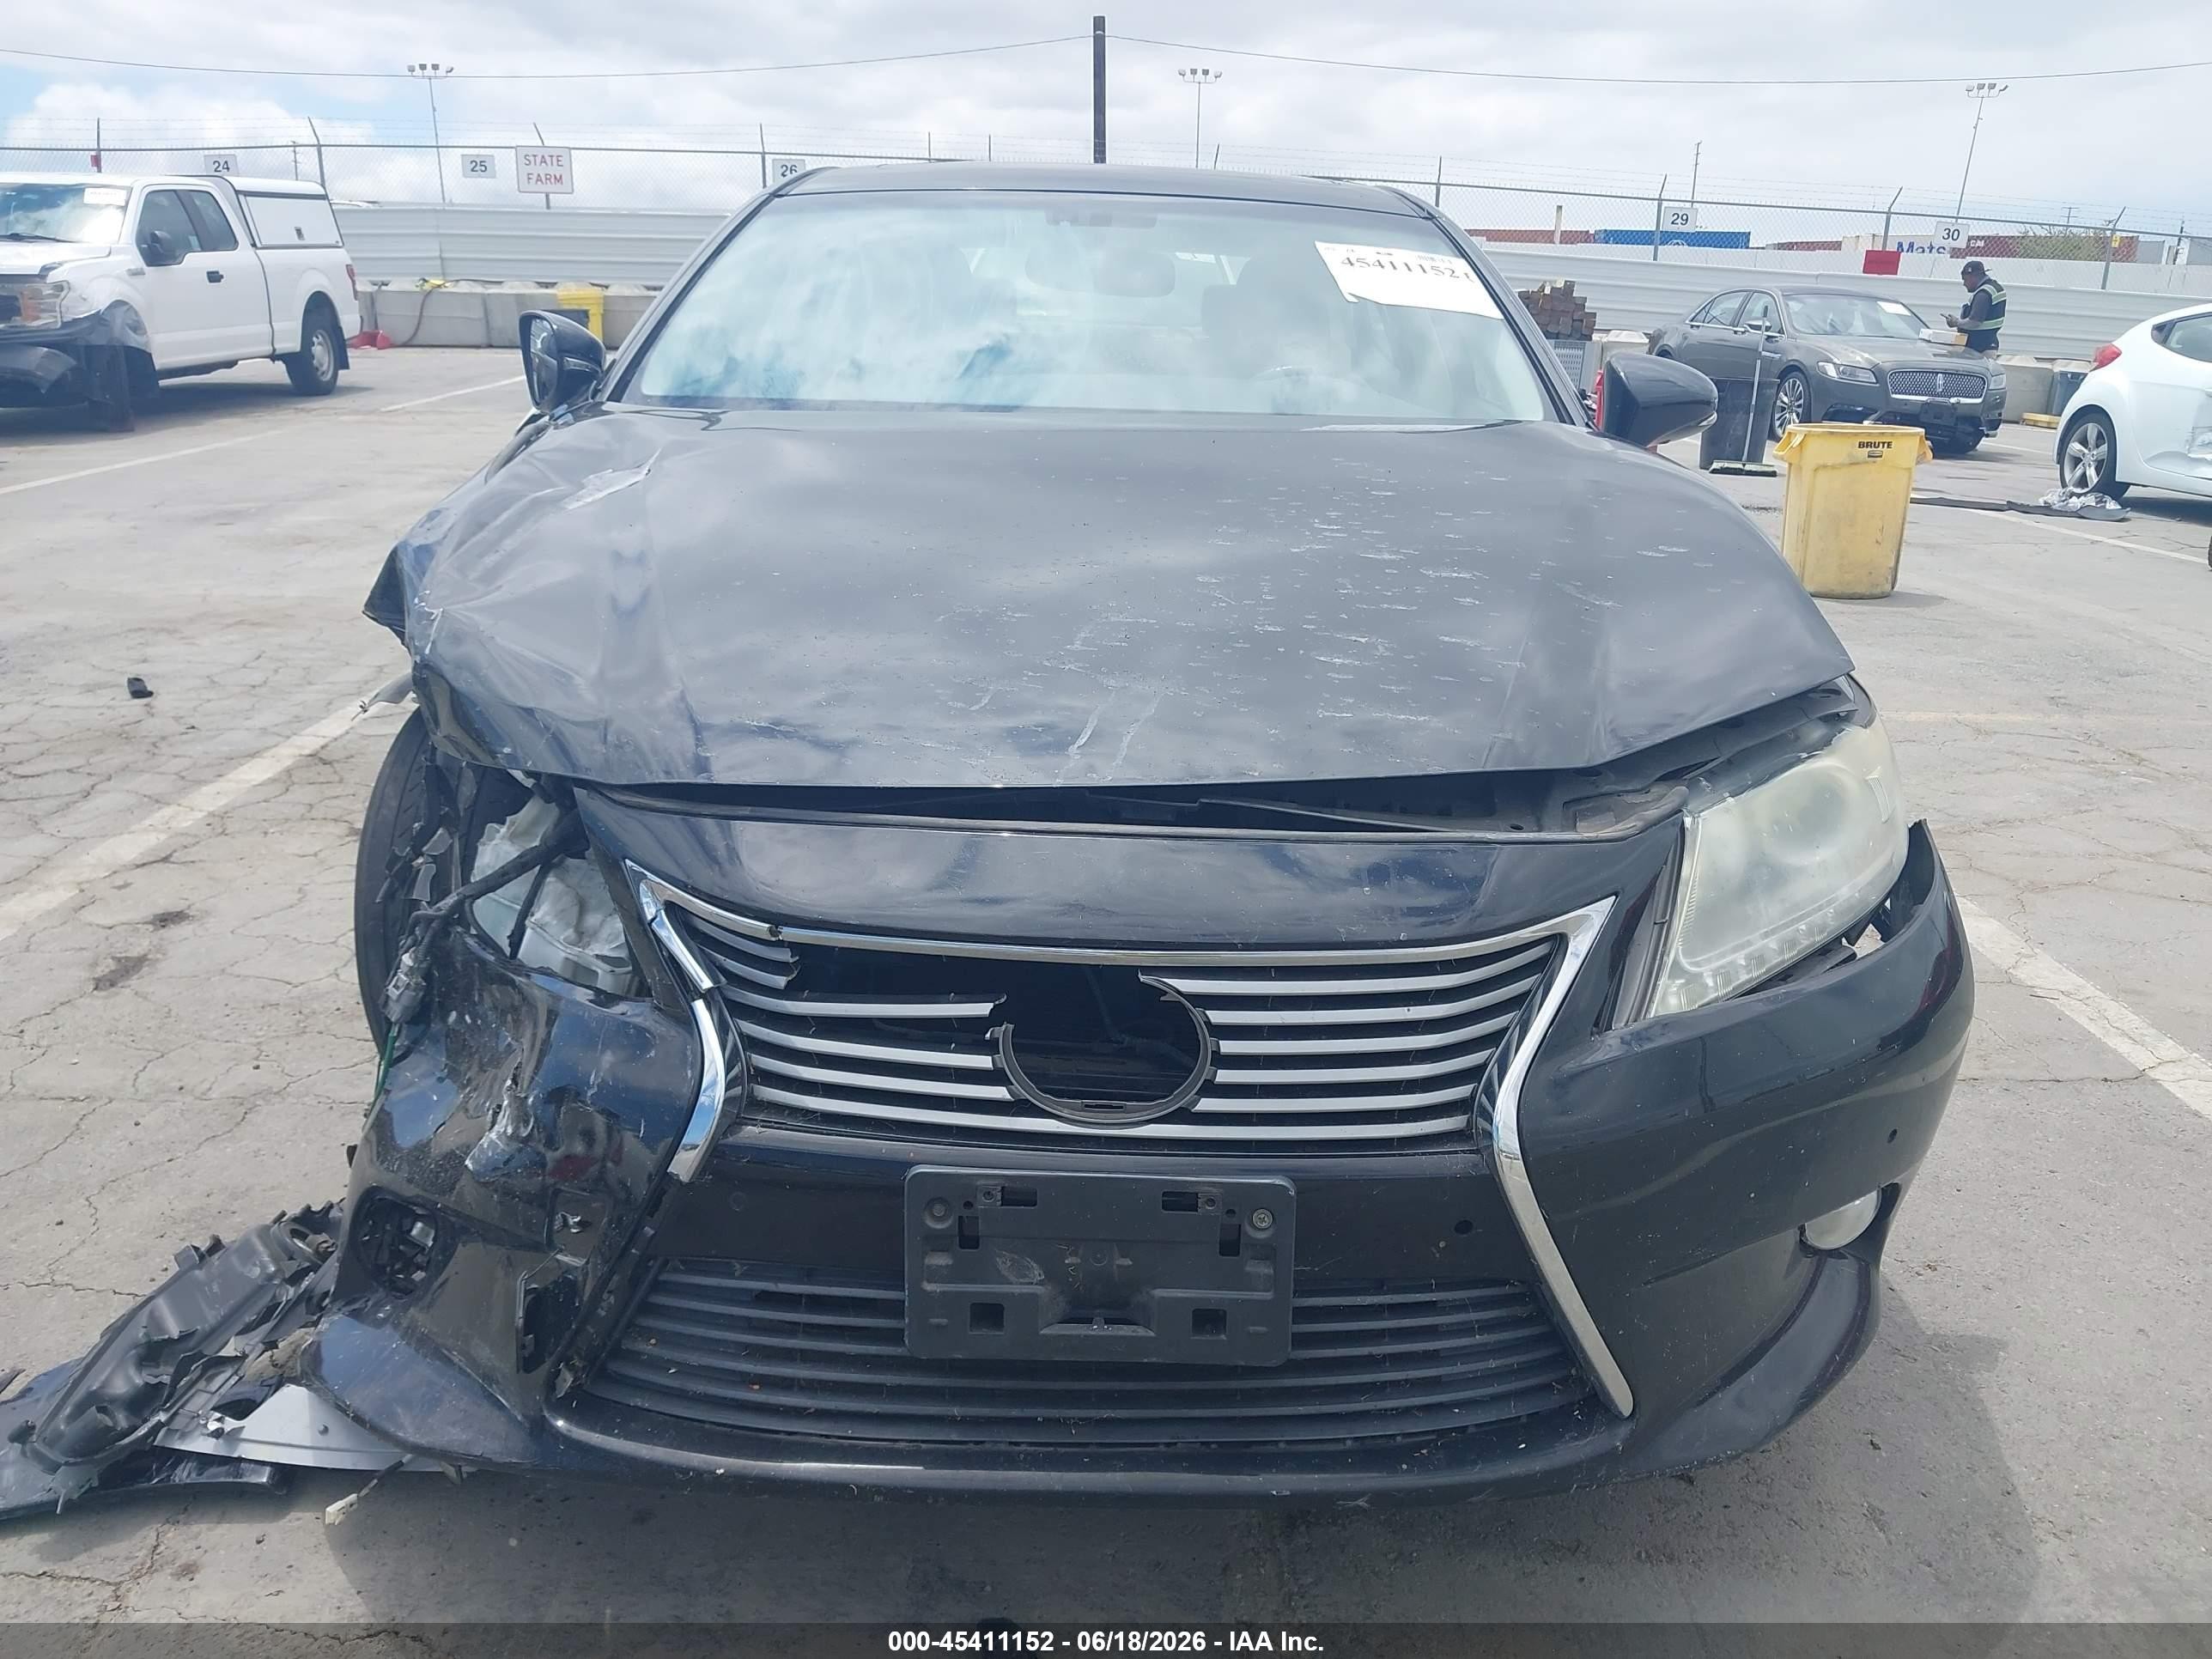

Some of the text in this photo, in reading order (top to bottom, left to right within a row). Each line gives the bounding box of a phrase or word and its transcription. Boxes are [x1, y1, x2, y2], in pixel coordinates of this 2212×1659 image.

[212, 161, 230, 173] 24
[470, 161, 488, 173] 25
[524, 154, 564, 167] STATE
[780, 163, 798, 177] 26
[526, 173, 564, 186] FARM
[1670, 212, 1689, 226] 29
[1942, 228, 1960, 241] 30
[1857, 441, 1893, 449] BRUTE
